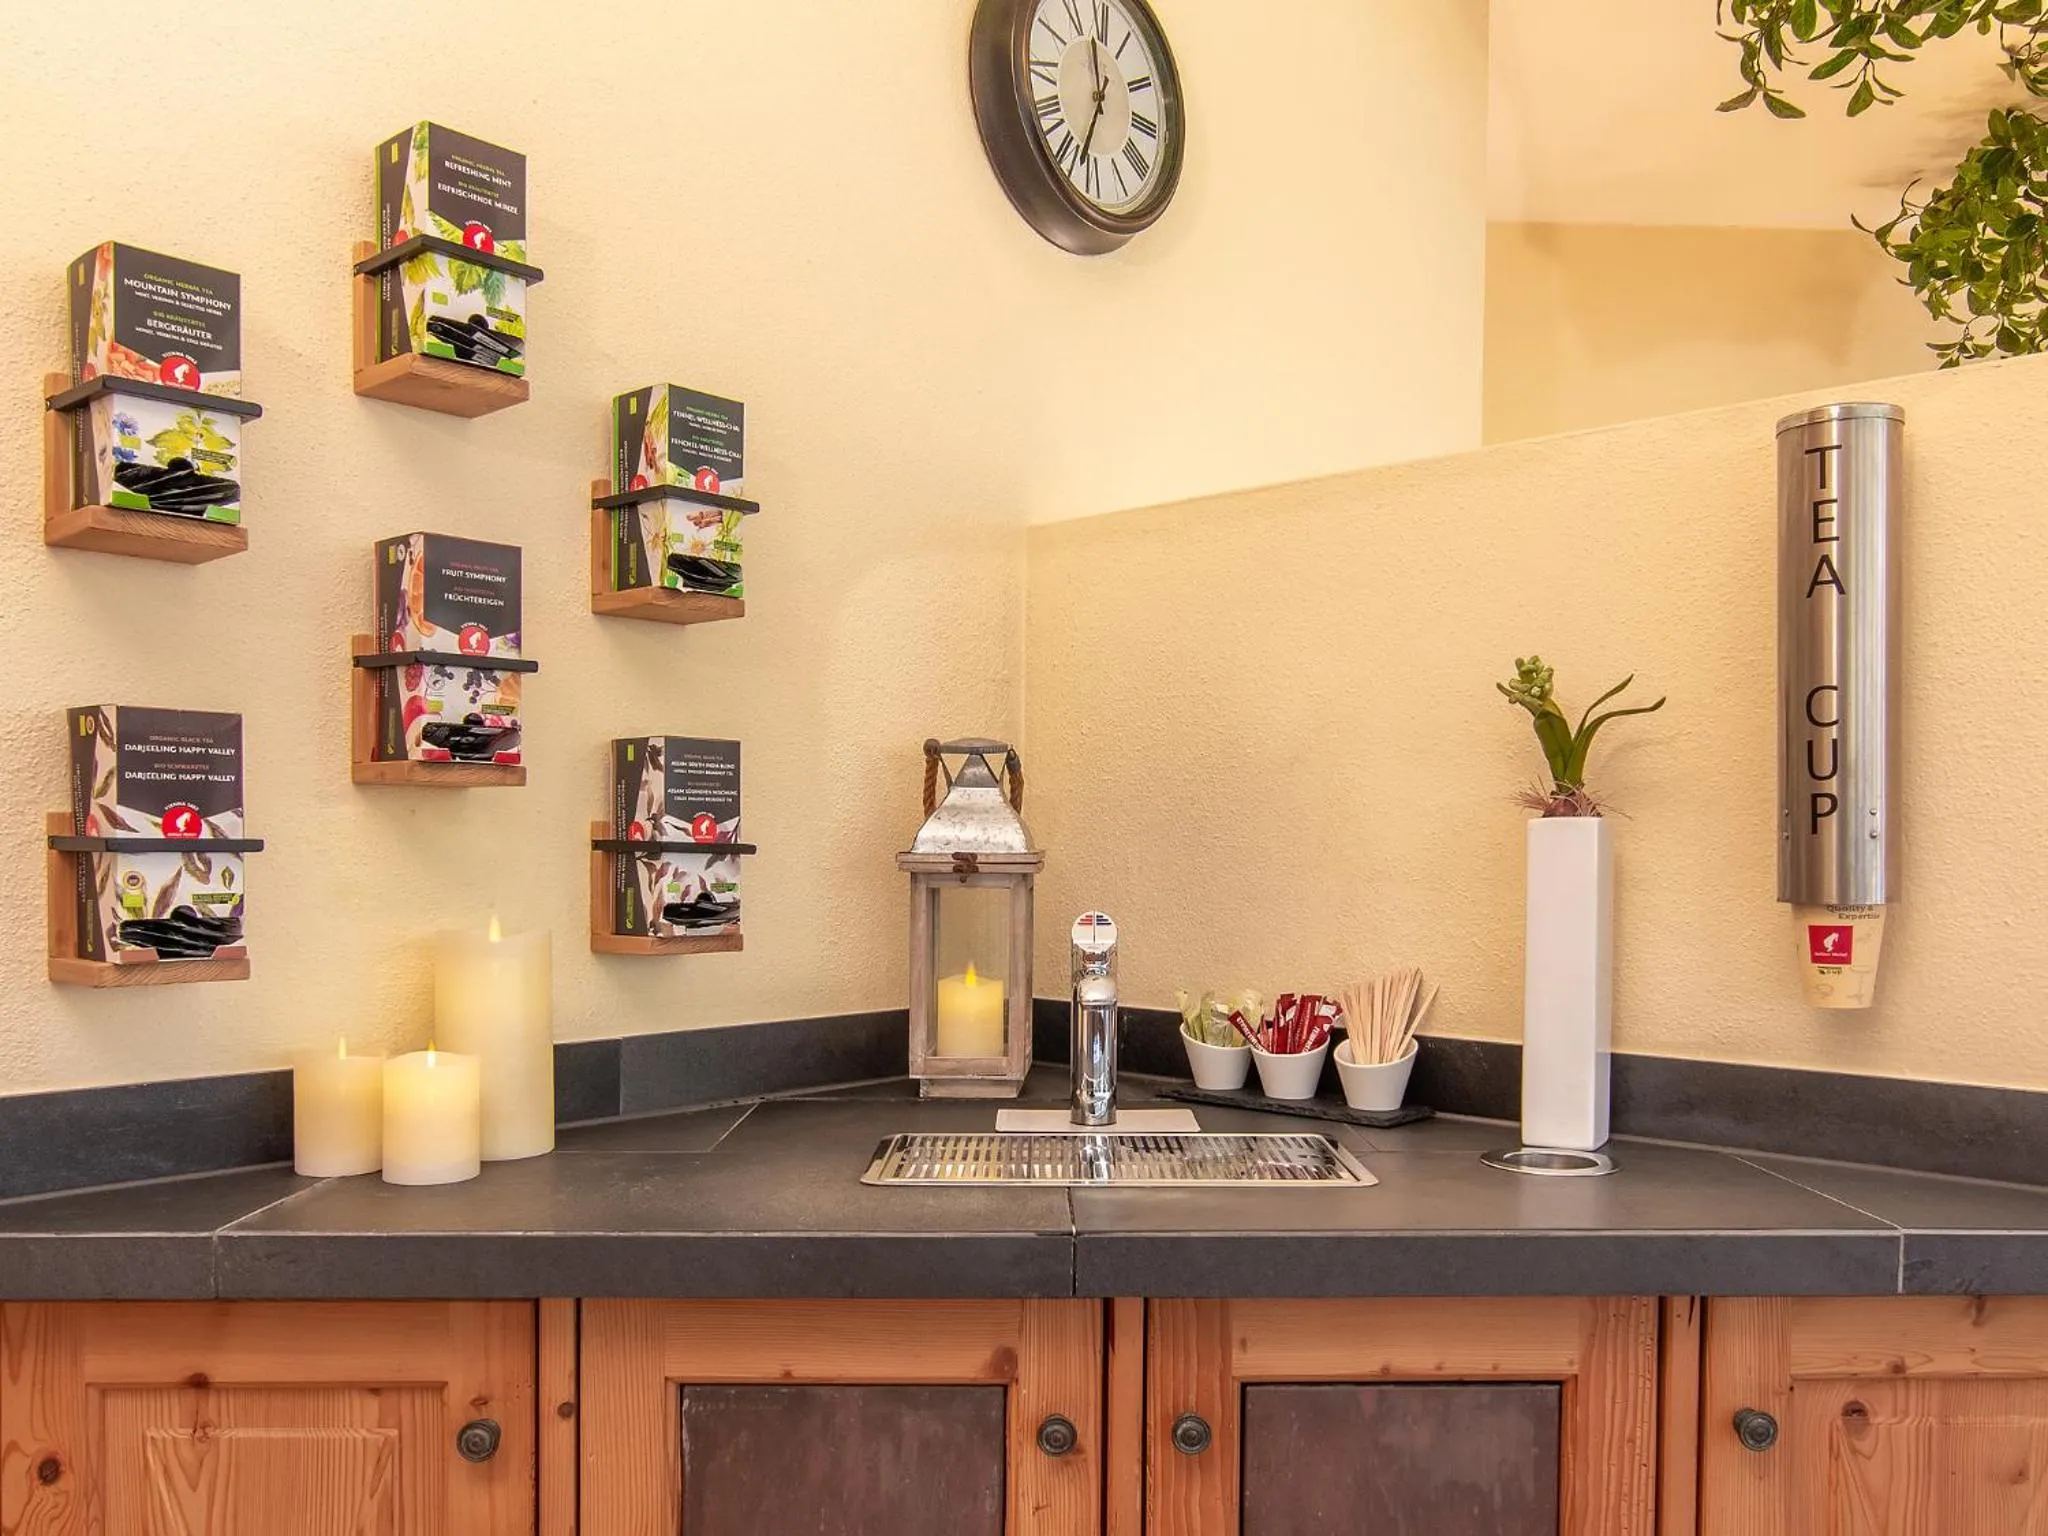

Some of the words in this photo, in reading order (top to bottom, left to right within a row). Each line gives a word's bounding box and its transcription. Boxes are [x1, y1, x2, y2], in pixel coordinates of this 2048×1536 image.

[444, 160, 491, 182] REFRESHING
[492, 176, 512, 188] MINT
[437, 182, 493, 207] ERFRISCHENDE
[124, 278, 179, 298] MOUNTAIN
[180, 291, 232, 311] SYMPHONY
[146, 318, 213, 340] BERGKRÄUTER
[1805, 444, 1846, 598] TEA
[441, 568, 464, 578] FRUIT
[465, 571, 508, 583] SYMPHONY
[444, 592, 505, 607] FRÜCHTEREIGEN
[124, 743, 177, 754] DARJEELING
[179, 746, 206, 754] HAPPY
[207, 747, 236, 756] VALLEY
[1805, 684, 1840, 835] CUP
[124, 771, 177, 781] DARJEELING
[178, 774, 206, 782] HAPPY
[207, 774, 236, 783] VALLEY
